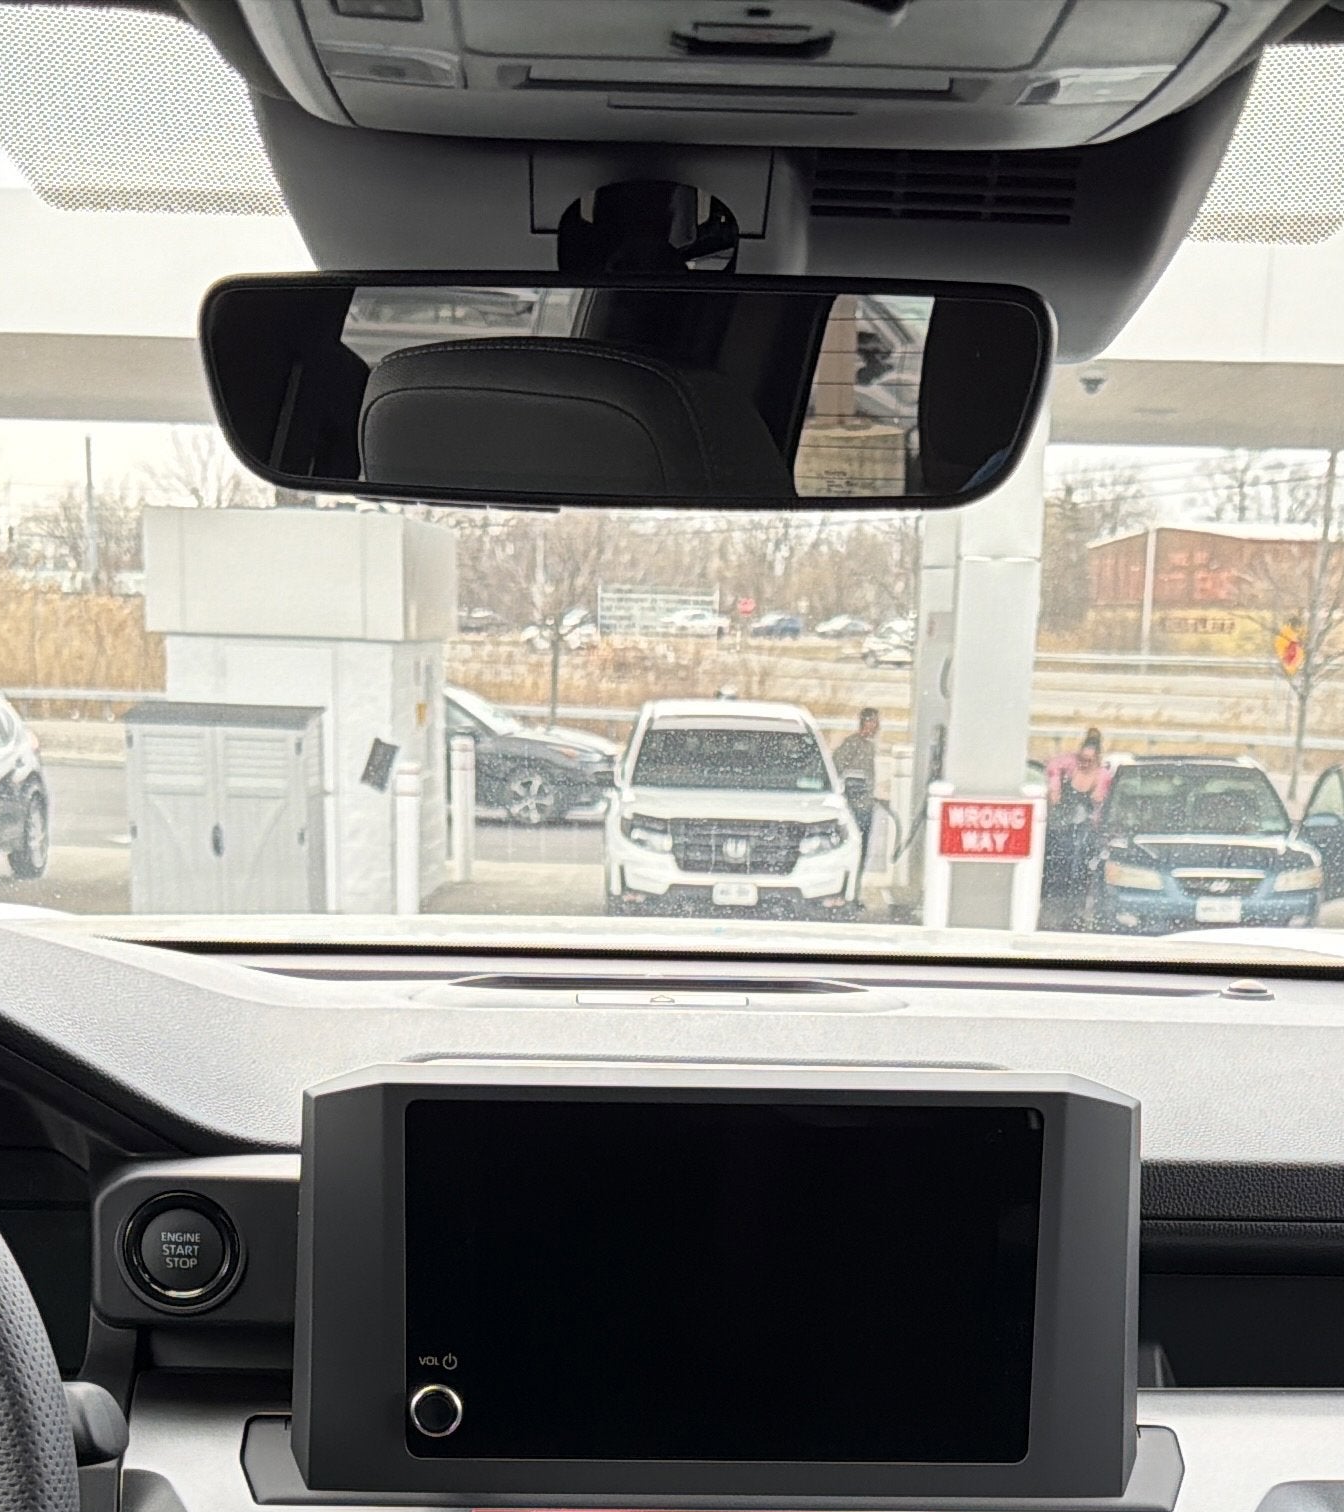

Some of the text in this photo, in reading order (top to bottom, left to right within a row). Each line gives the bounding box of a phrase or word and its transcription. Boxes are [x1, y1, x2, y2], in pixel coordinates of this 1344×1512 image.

[948, 804, 1027, 830] WRONG
[960, 829, 1010, 853] WAY
[160, 1231, 201, 1243] ENGINE
[162, 1243, 200, 1256] START
[165, 1257, 198, 1269] STOP
[418, 1355, 440, 1366] VOL
